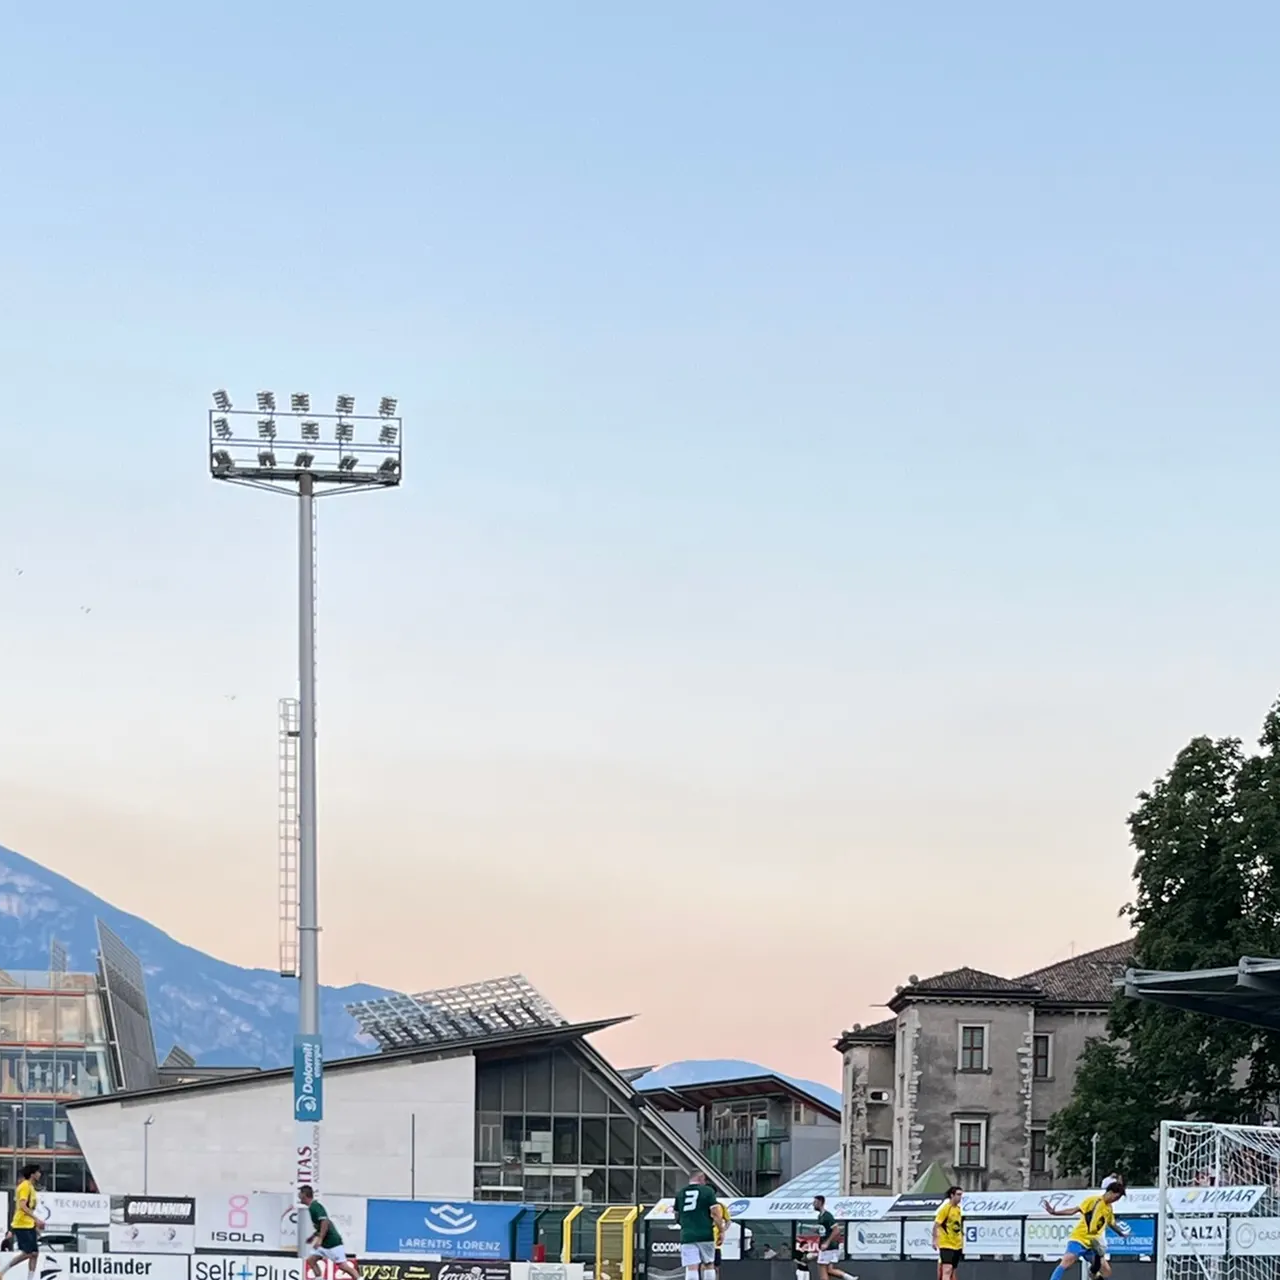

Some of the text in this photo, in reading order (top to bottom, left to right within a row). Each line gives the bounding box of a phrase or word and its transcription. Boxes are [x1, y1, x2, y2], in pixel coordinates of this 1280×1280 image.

[302, 1043, 314, 1094] Dolomiti
[297, 1145, 313, 1183] ITAS
[683, 1190, 700, 1212] 3
[211, 1231, 265, 1243] ISOLA
[978, 1226, 1020, 1238] GIACCA
[399, 1238, 501, 1251] LARENTIS LORENZ
[70, 1256, 153, 1276] Holländer
